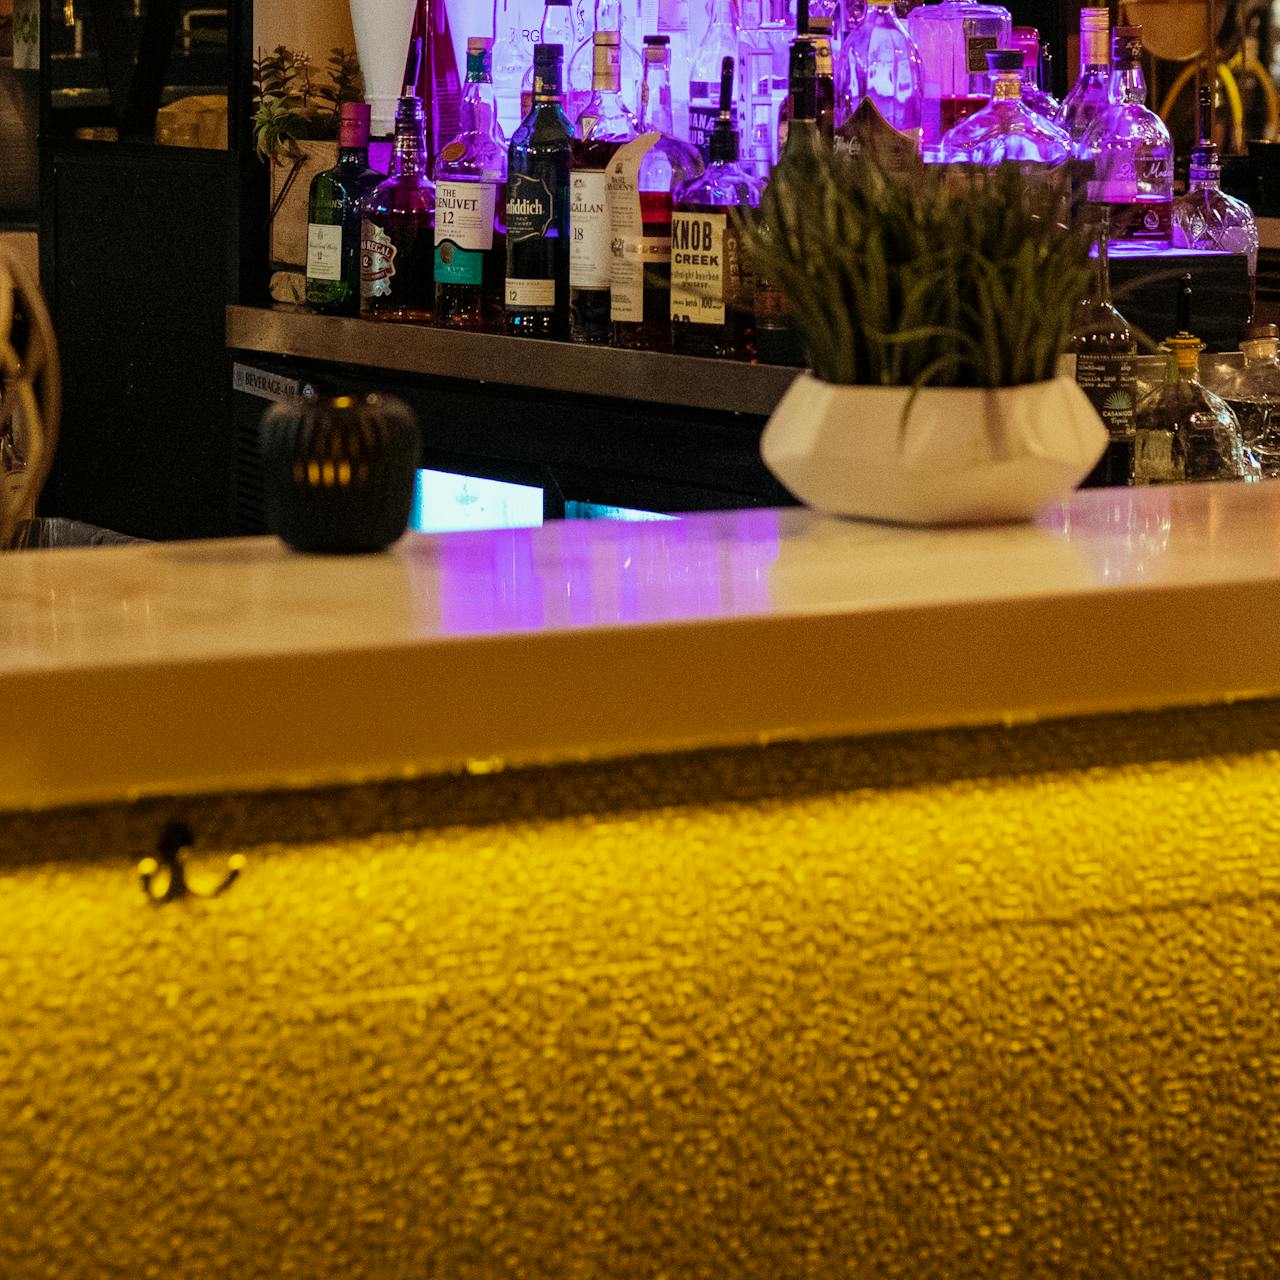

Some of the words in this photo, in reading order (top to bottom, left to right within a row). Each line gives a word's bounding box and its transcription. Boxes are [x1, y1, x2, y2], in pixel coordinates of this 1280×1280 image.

[442, 188, 457, 197] THE
[436, 198, 478, 211] ENLIVET
[442, 212, 454, 224] 12
[573, 227, 584, 240] 18
[672, 219, 712, 251] KNOB
[675, 253, 718, 266] CREEK
[509, 290, 518, 301] 12
